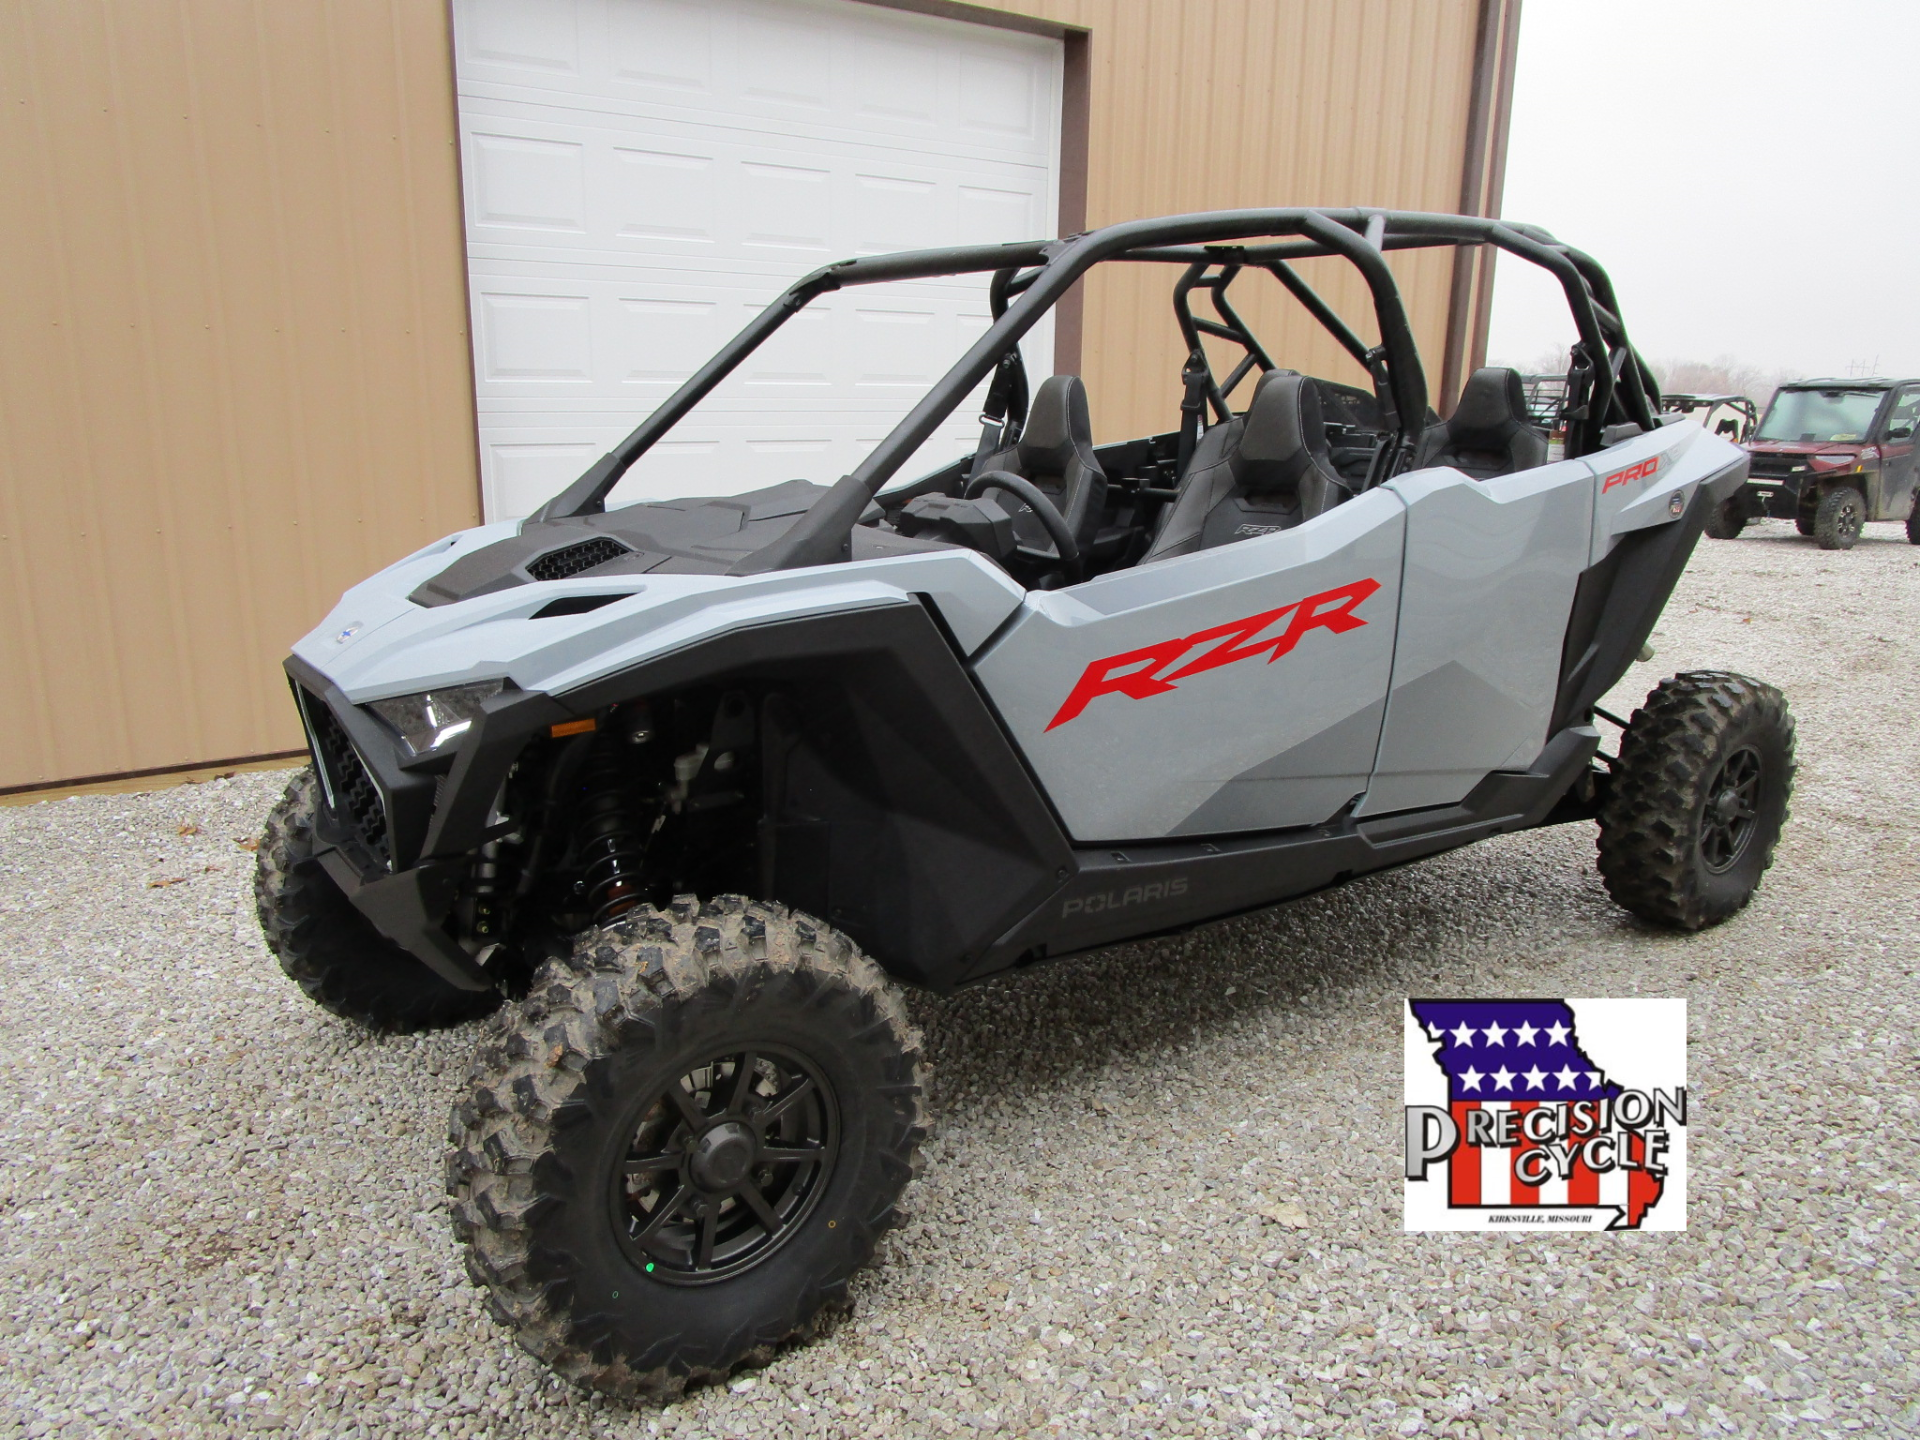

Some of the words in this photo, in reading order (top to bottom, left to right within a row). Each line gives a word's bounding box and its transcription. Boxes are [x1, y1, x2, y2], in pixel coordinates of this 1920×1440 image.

[1602, 457, 1659, 493] PRO
[1043, 577, 1382, 733] RZR
[1062, 877, 1188, 919] POLARIS
